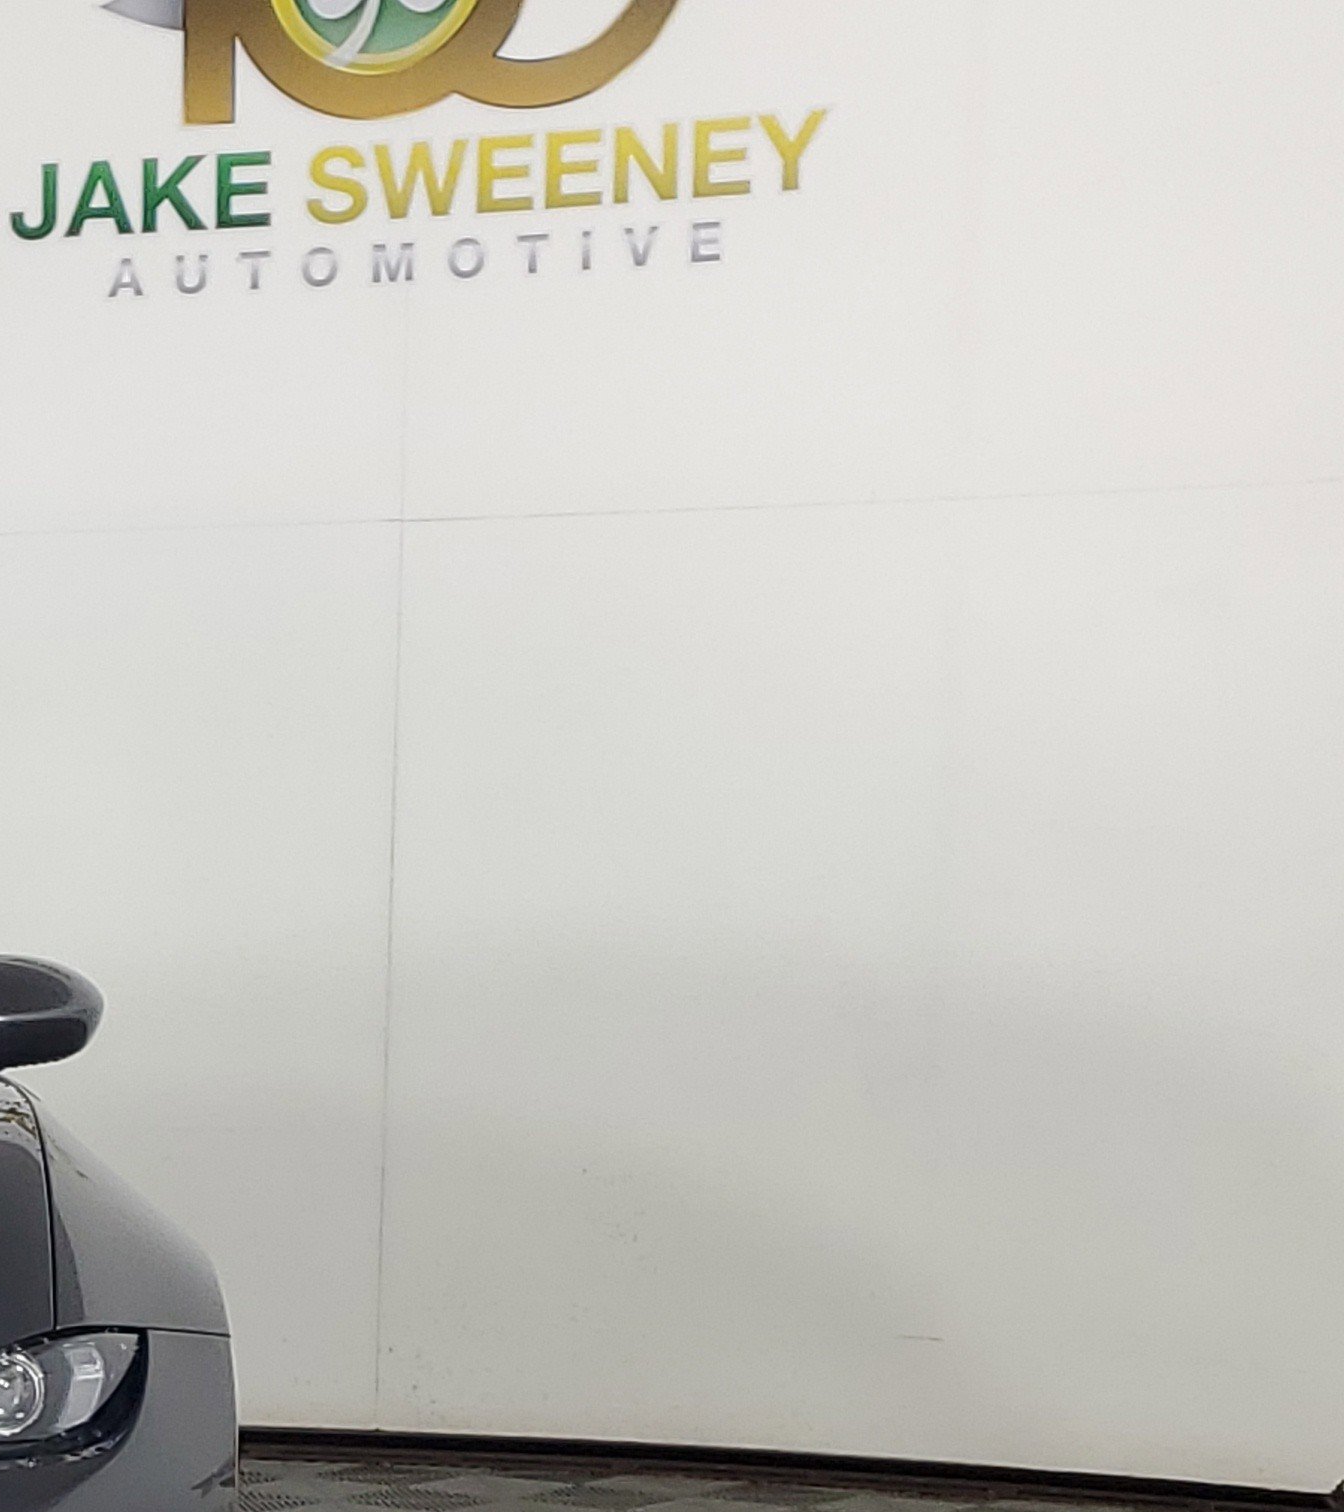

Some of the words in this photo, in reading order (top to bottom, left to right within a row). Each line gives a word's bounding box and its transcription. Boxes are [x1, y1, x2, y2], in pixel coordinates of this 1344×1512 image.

[9, 150, 272, 241] JAKE
[306, 108, 828, 225] SWEENEY
[108, 220, 722, 298] AUTOMOTIVE
